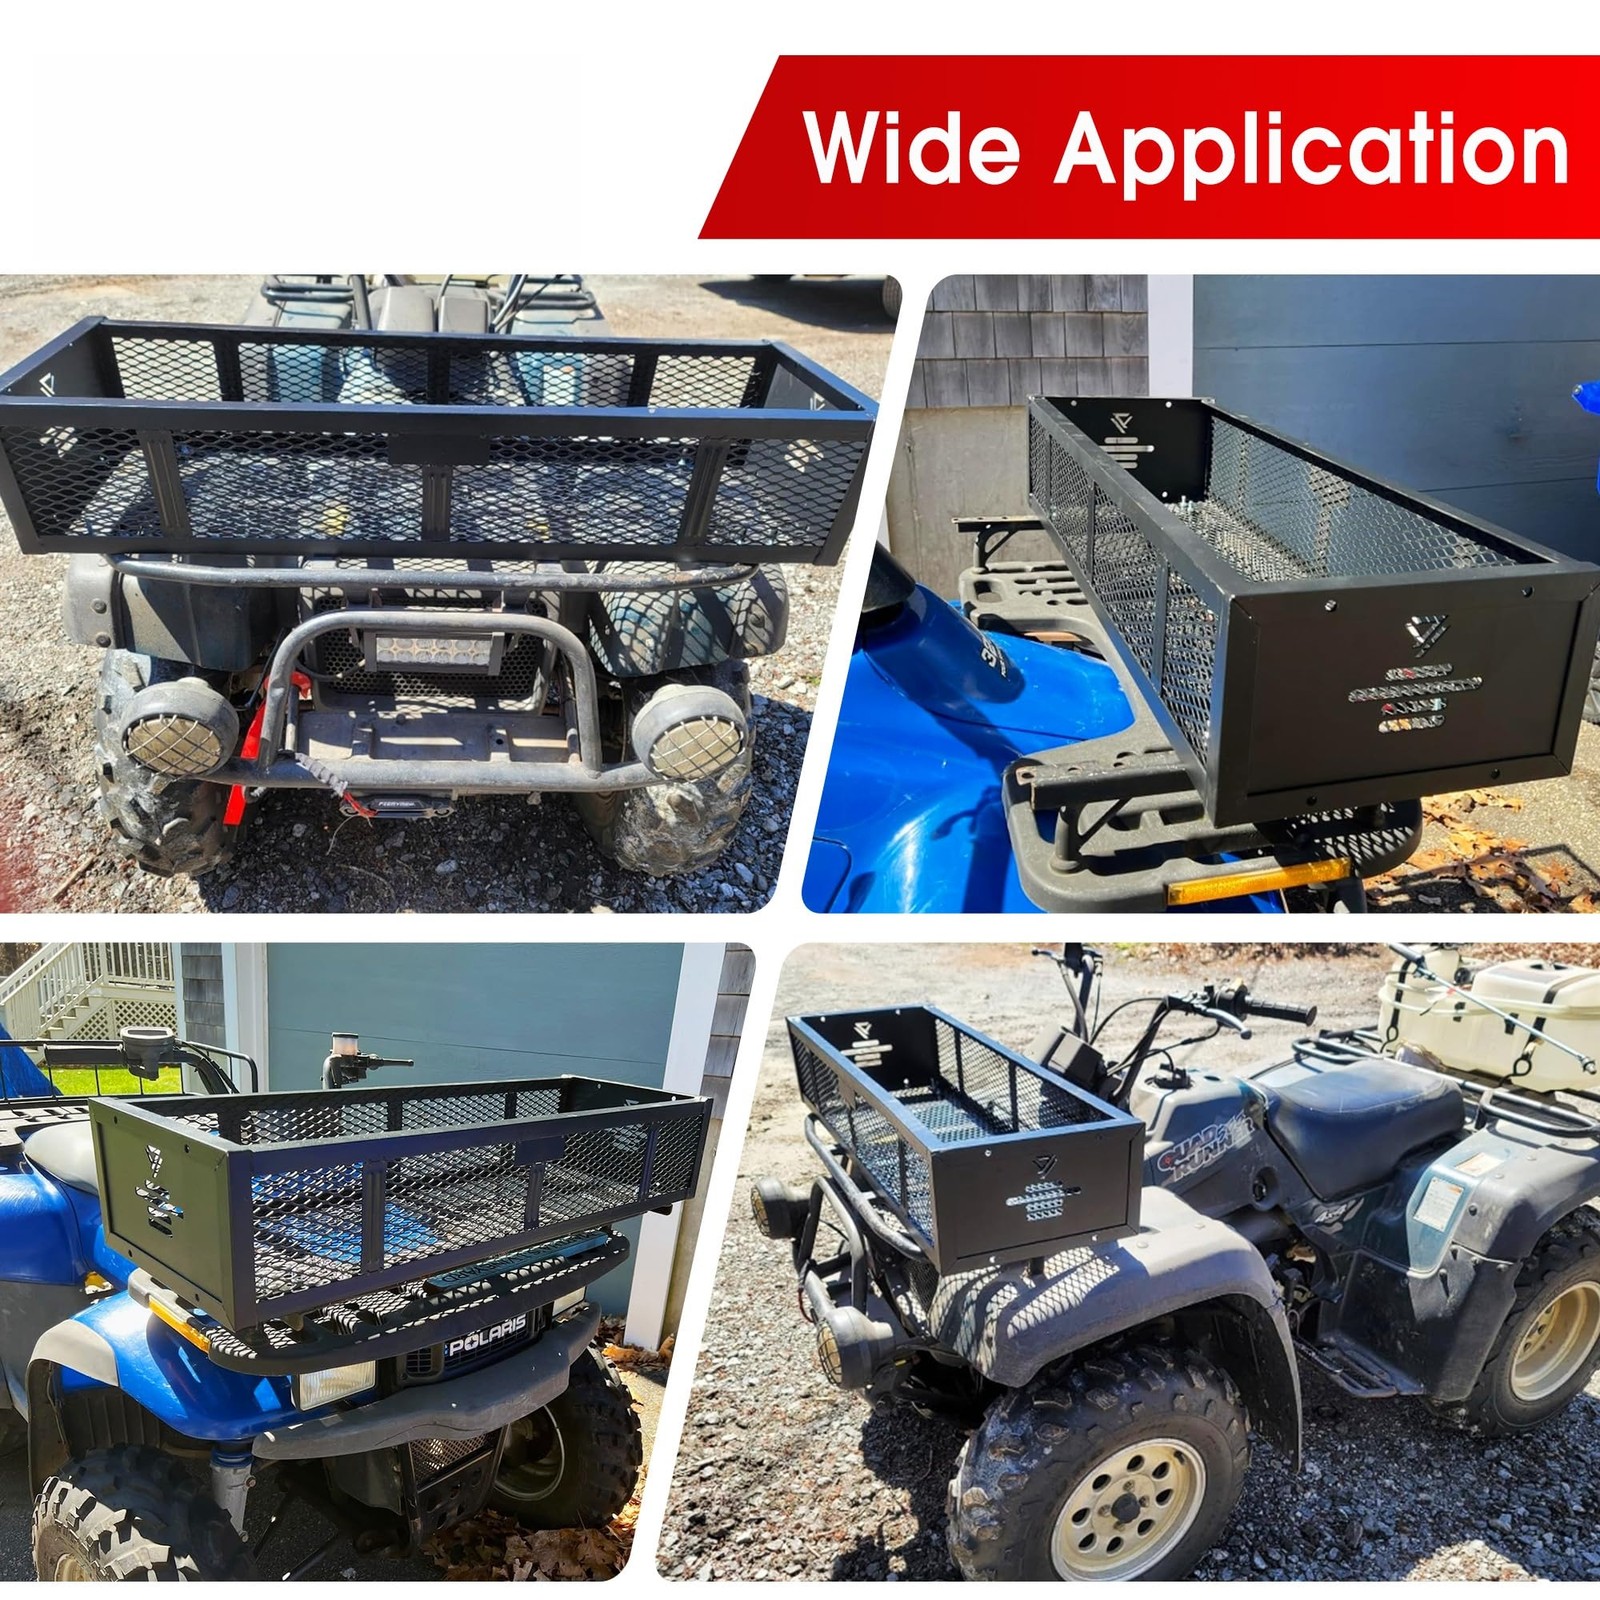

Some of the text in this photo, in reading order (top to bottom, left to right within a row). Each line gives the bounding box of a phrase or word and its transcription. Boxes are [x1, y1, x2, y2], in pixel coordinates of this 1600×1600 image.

[1157, 1124, 1219, 1172] QUAD
[1172, 1117, 1255, 1182] RUNNER
[449, 1313, 526, 1357] POLARIS
